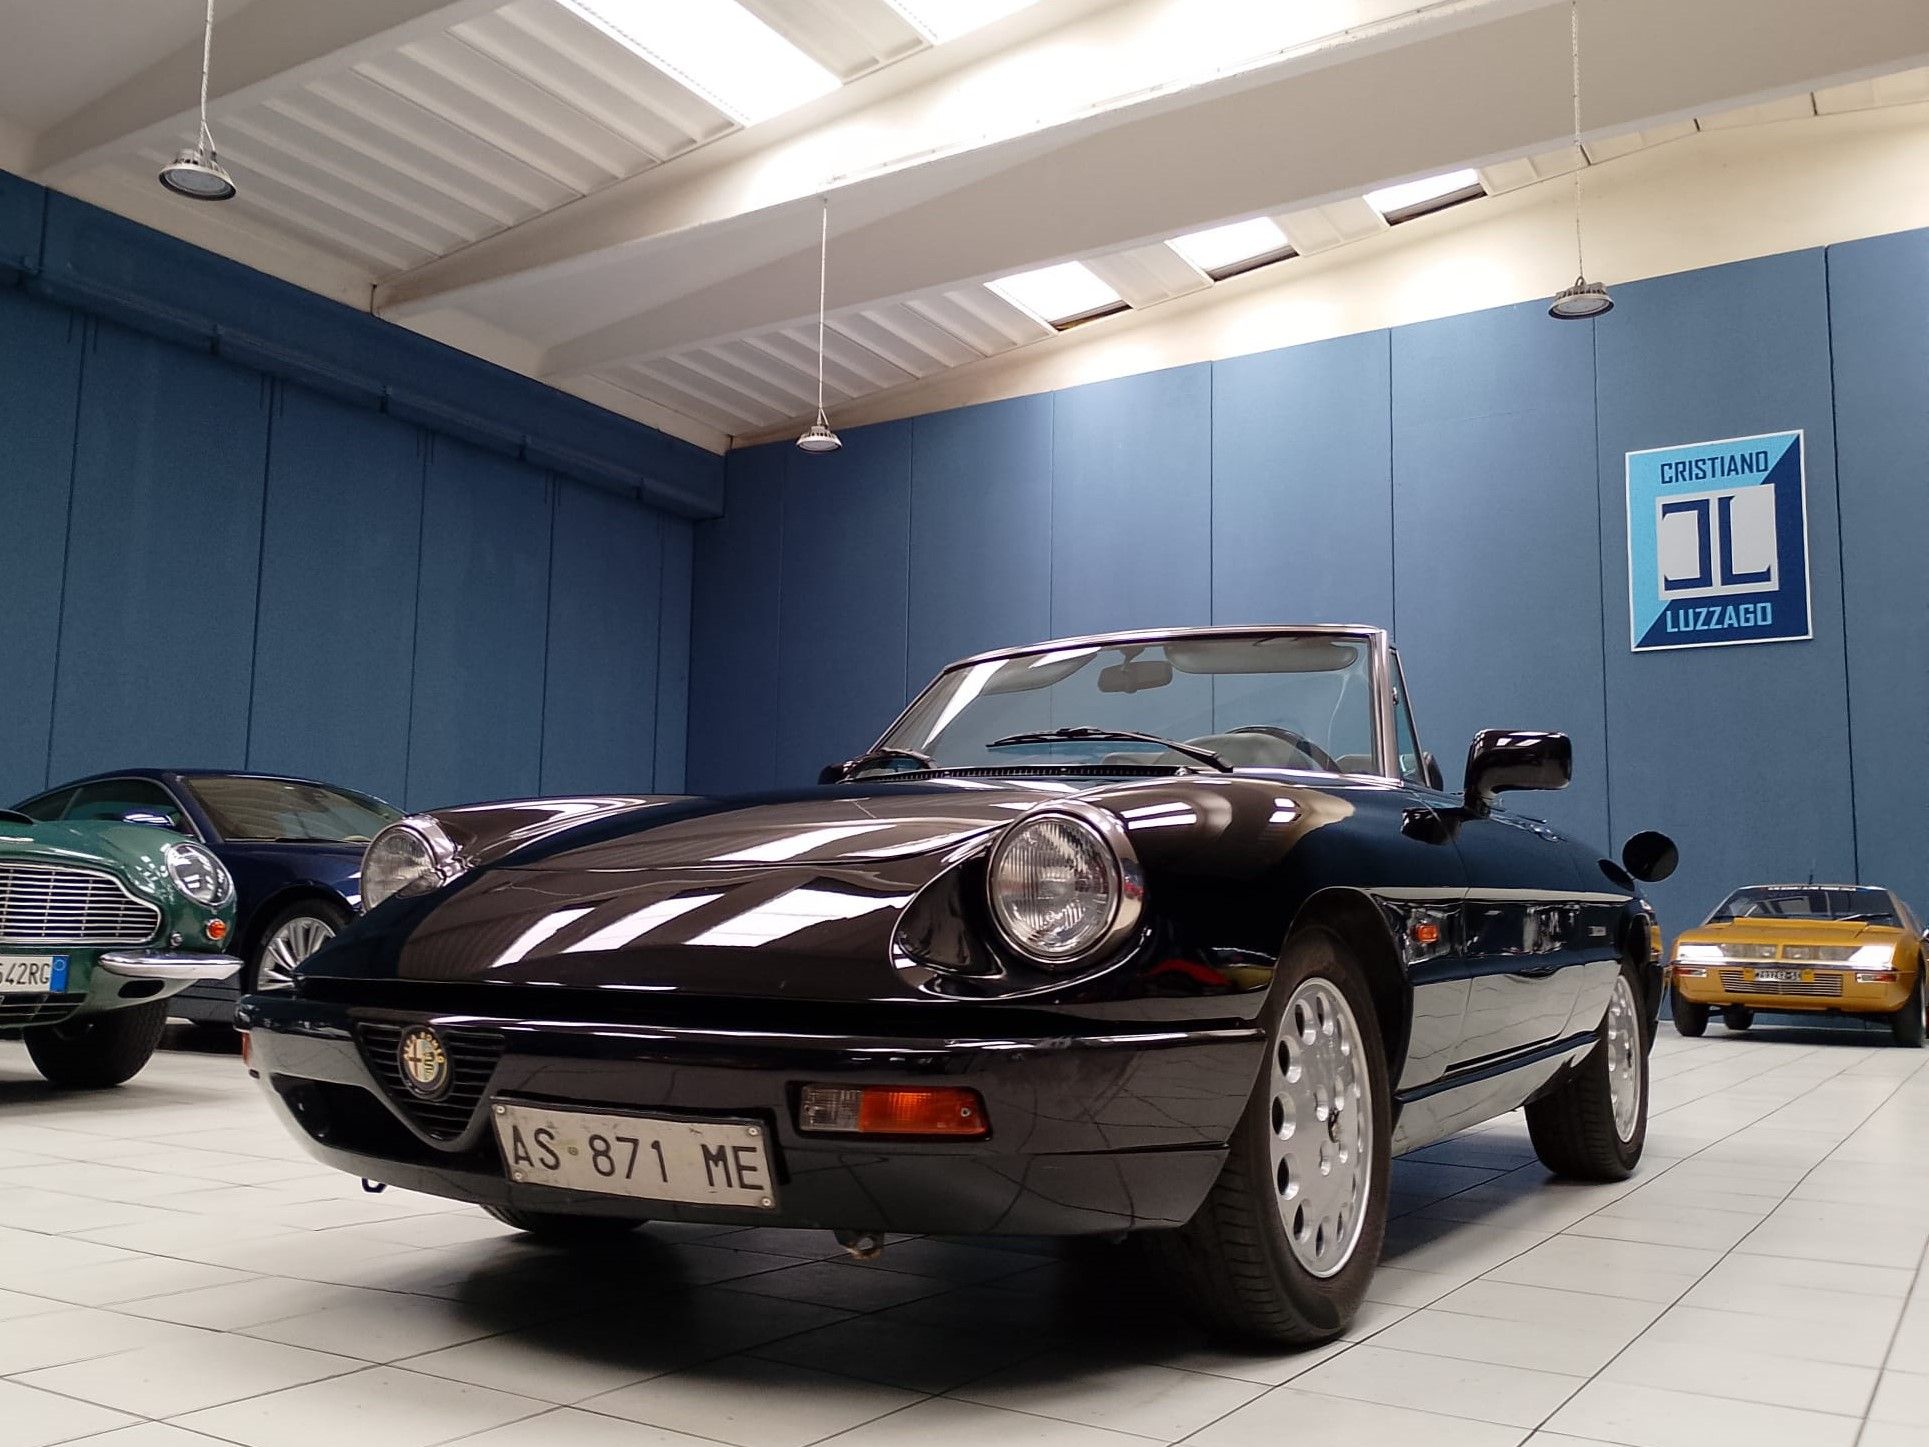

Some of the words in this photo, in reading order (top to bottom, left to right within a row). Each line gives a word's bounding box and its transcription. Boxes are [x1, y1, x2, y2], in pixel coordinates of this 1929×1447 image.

[1660, 450, 1769, 485] CRISTIANO
[1666, 602, 1773, 633] LUZZAGO
[0, 962, 50, 985] 42RG
[512, 1124, 562, 1171] AS
[588, 1133, 669, 1184] 871
[700, 1143, 764, 1191] ME
